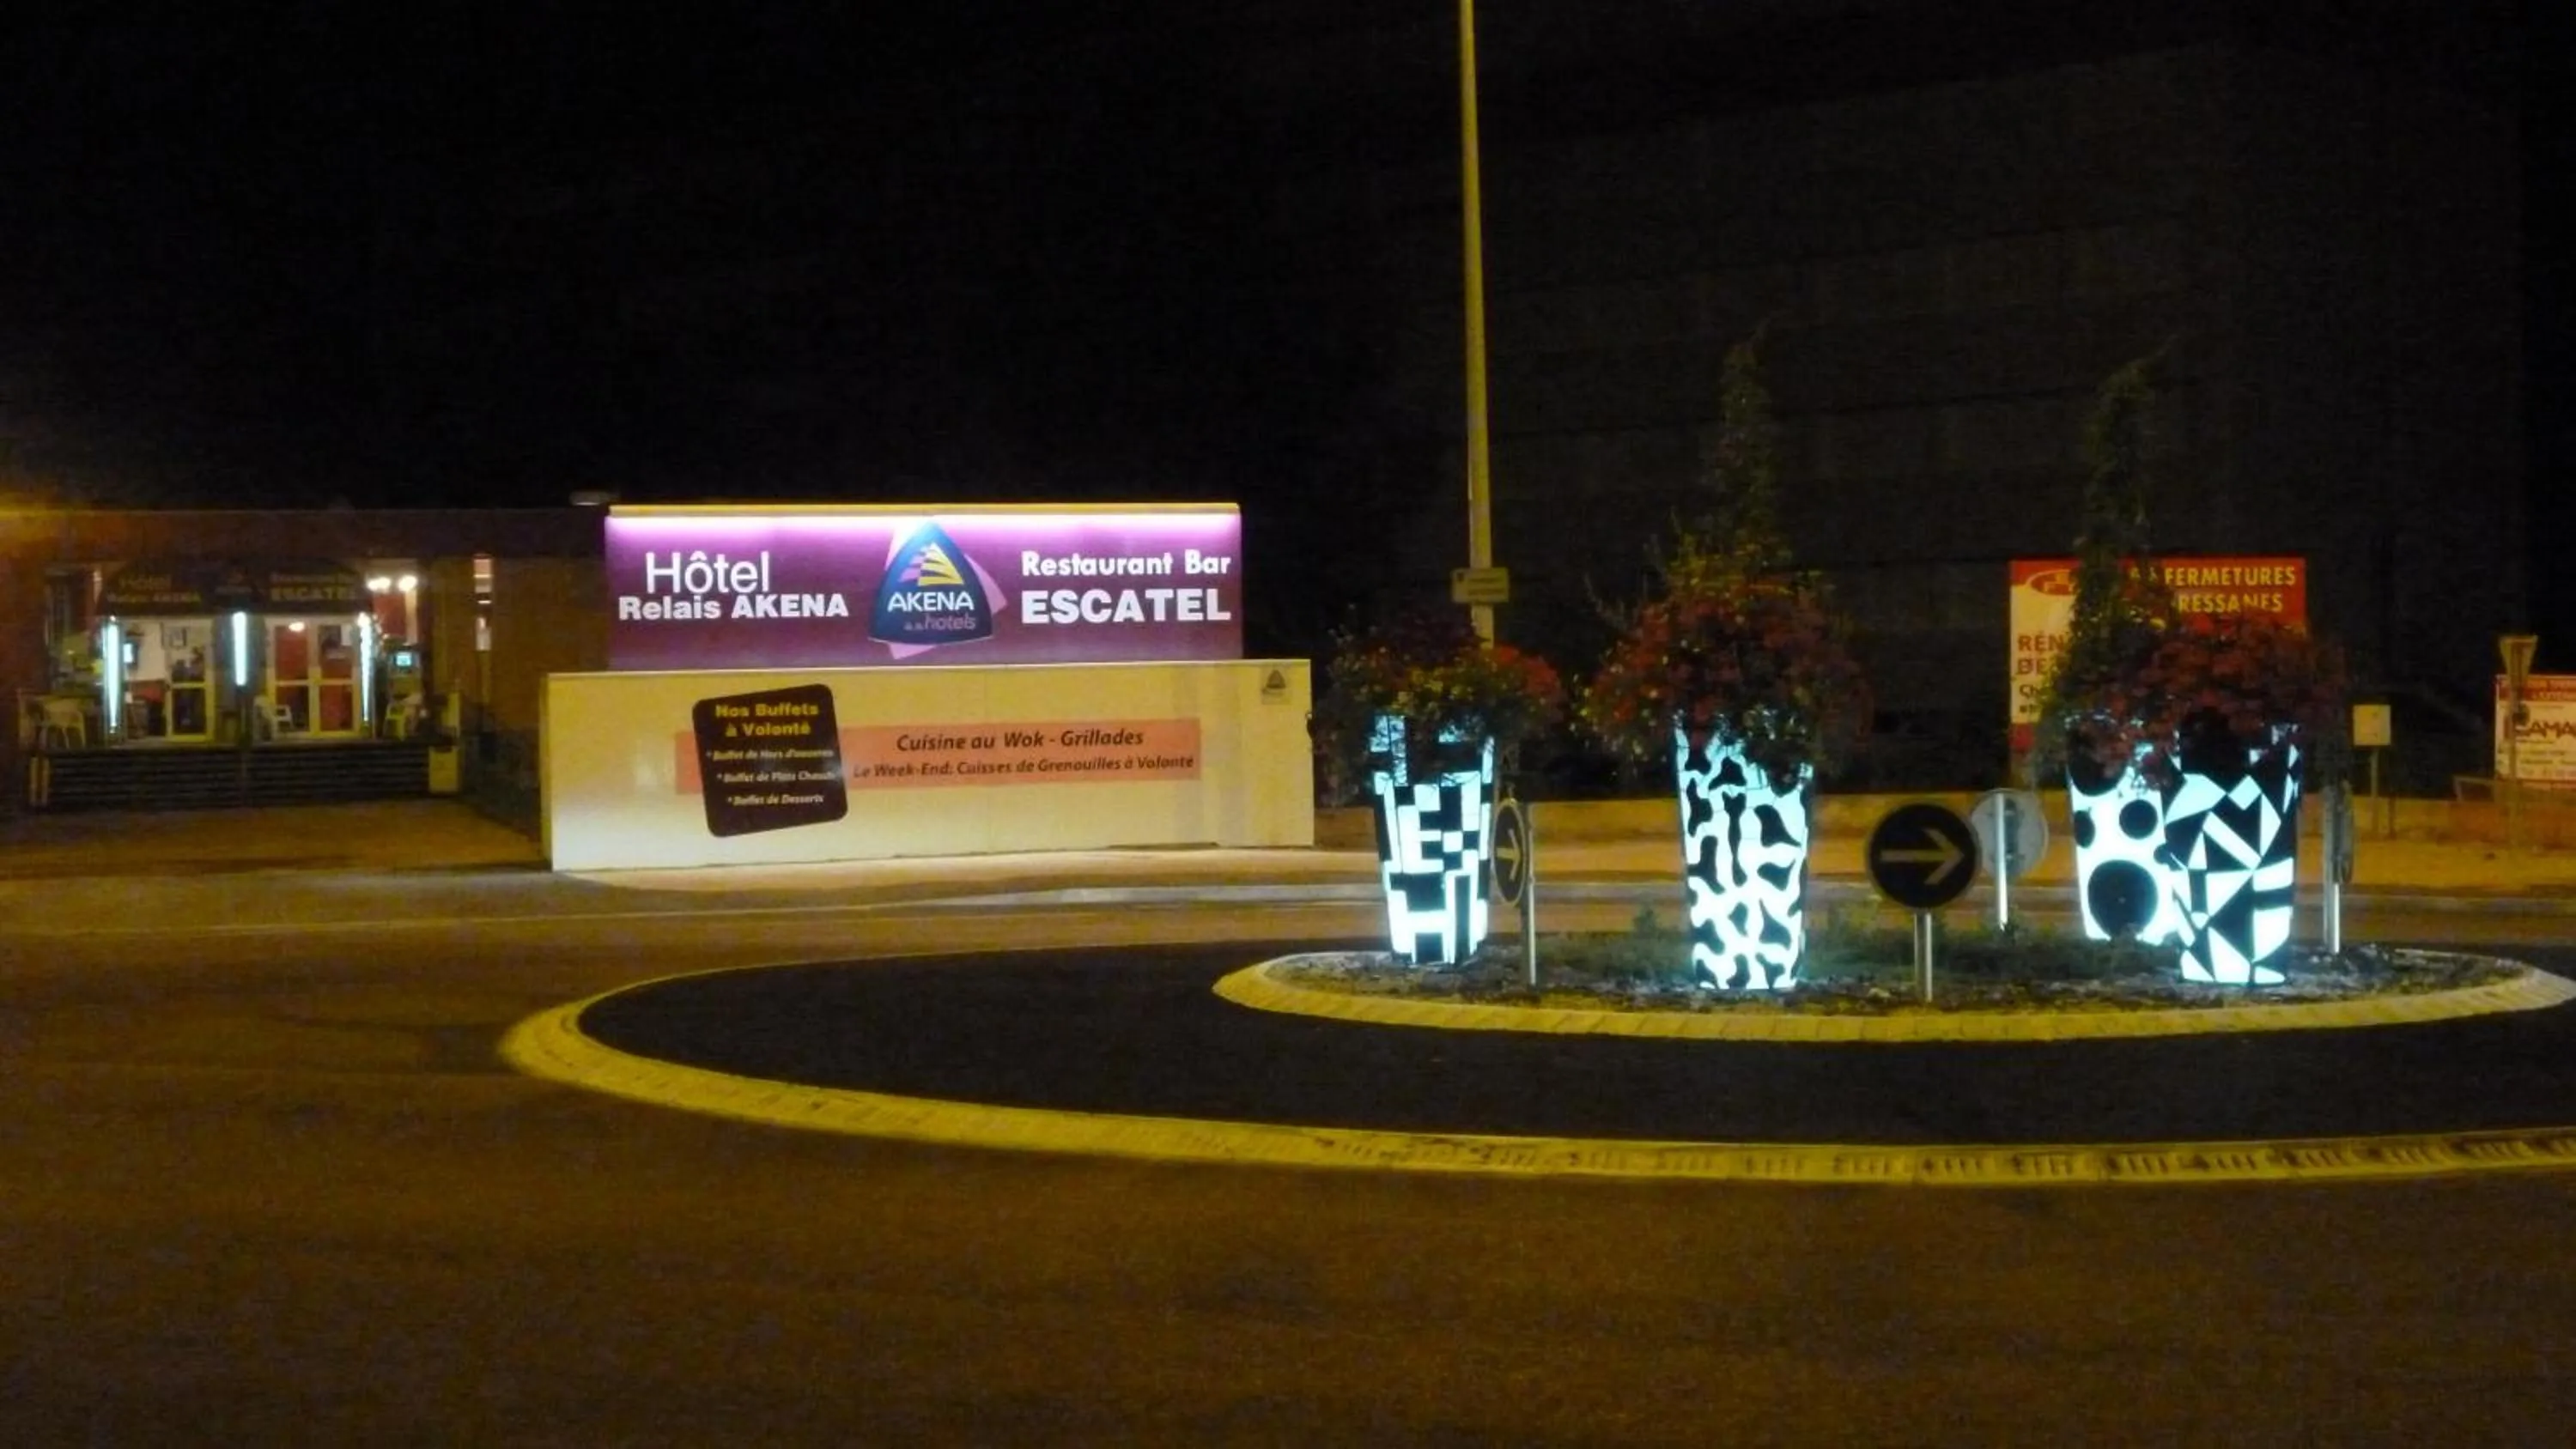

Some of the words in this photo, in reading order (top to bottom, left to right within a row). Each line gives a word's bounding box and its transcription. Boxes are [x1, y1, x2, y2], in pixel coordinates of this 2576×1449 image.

[645, 550, 771, 594] Hôtel
[1020, 551, 1175, 576] Restaurant
[1184, 549, 1231, 574] Bar
[2165, 567, 2296, 585] FERMETURES
[618, 597, 722, 621] Relais
[731, 593, 850, 619] AKENA
[887, 591, 975, 612] AKENA
[1021, 588, 1232, 625] ESCATEL
[2172, 593, 2284, 613] RESSANES
[715, 705, 750, 718] Nos
[755, 702, 819, 716] Buffets
[742, 722, 811, 737] Volonté
[896, 733, 965, 752] Cuisine
[971, 737, 994, 749] au
[1004, 731, 1044, 749] Wok
[1060, 729, 1144, 747] Grillades
[854, 765, 870, 778] Le
[957, 761, 1011, 774] Cuisses
[1016, 759, 1034, 773] de
[1037, 756, 1121, 772] Grenouilles
[1124, 757, 1133, 769] à
[1138, 755, 1194, 769] Volonté
